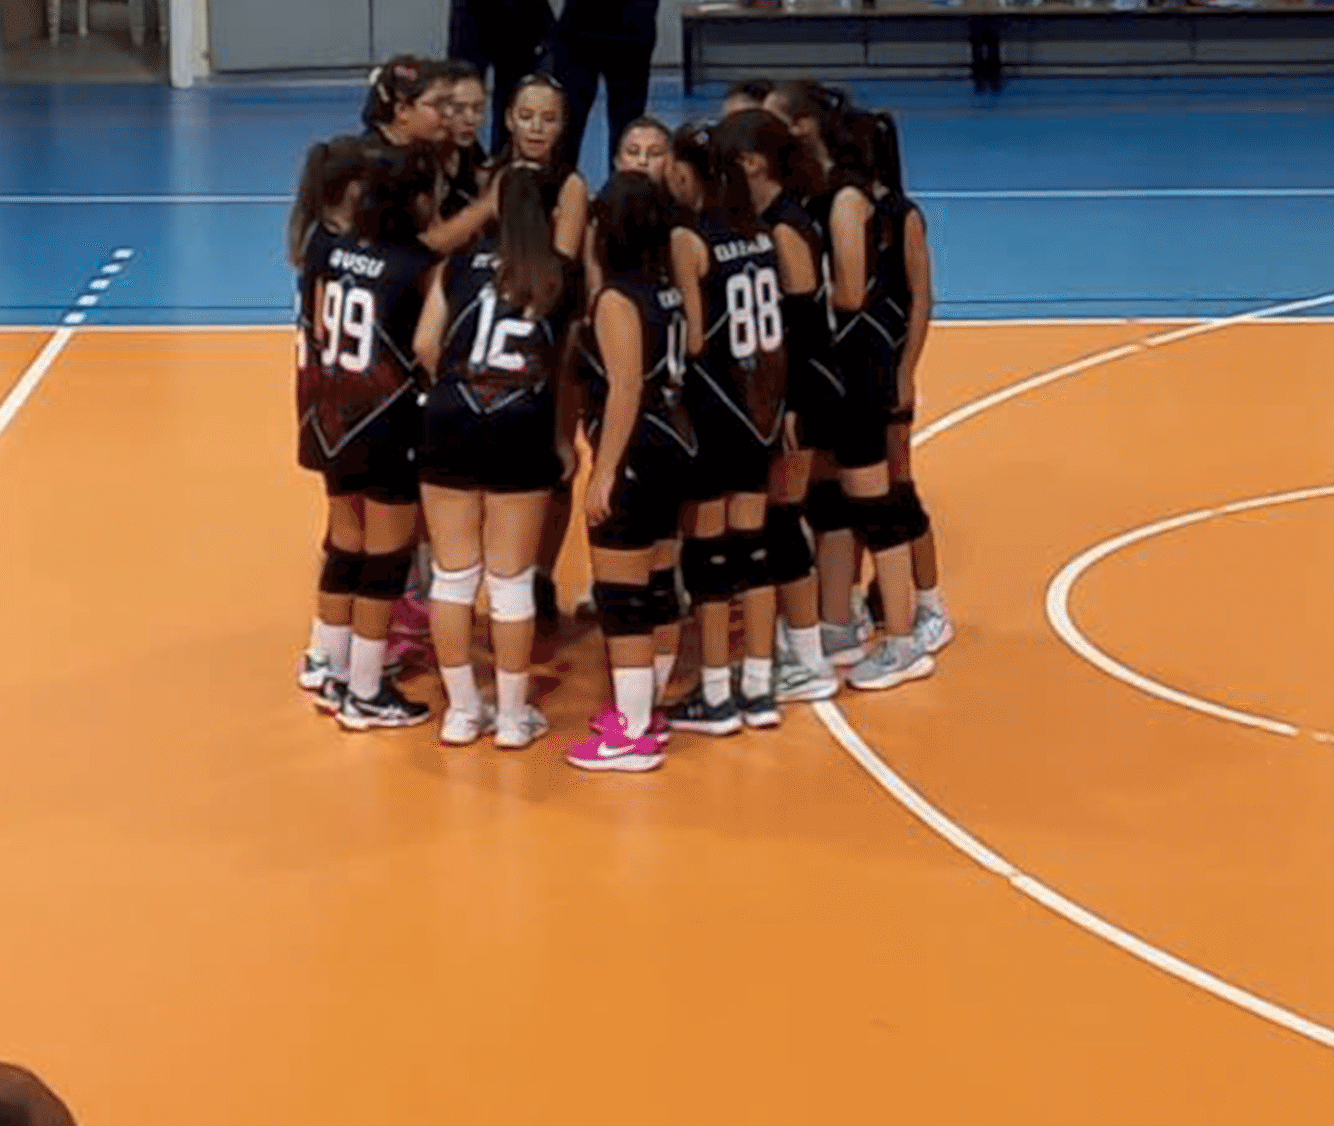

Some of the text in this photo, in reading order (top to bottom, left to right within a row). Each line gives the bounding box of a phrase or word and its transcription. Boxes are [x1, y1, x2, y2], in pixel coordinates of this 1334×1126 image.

[321, 281, 375, 372] 99
[468, 285, 536, 371] 12
[726, 267, 784, 359] 88
